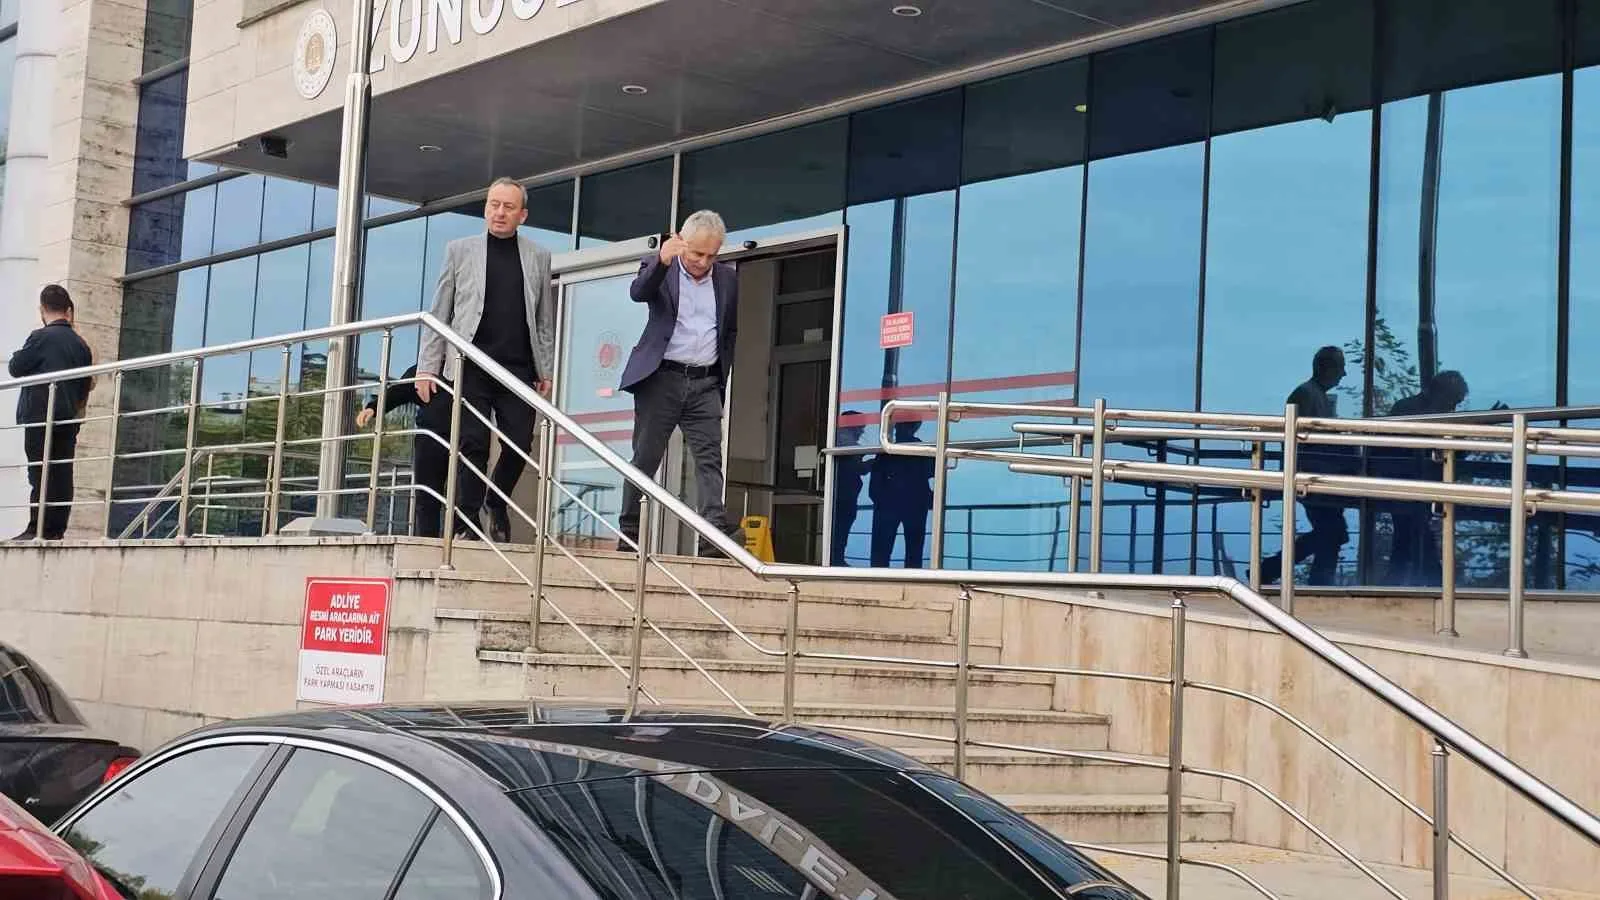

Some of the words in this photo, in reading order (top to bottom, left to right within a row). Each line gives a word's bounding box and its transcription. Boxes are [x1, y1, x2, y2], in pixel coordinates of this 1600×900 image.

[330, 592, 360, 609] ADLİYE
[329, 611, 368, 625] ARAÇLARINA
[369, 611, 380, 624] AİT
[314, 626, 337, 641] PARK
[339, 625, 374, 644] YERİDİR.
[303, 677, 317, 688] PARK
[320, 679, 344, 690] YAPMASI
